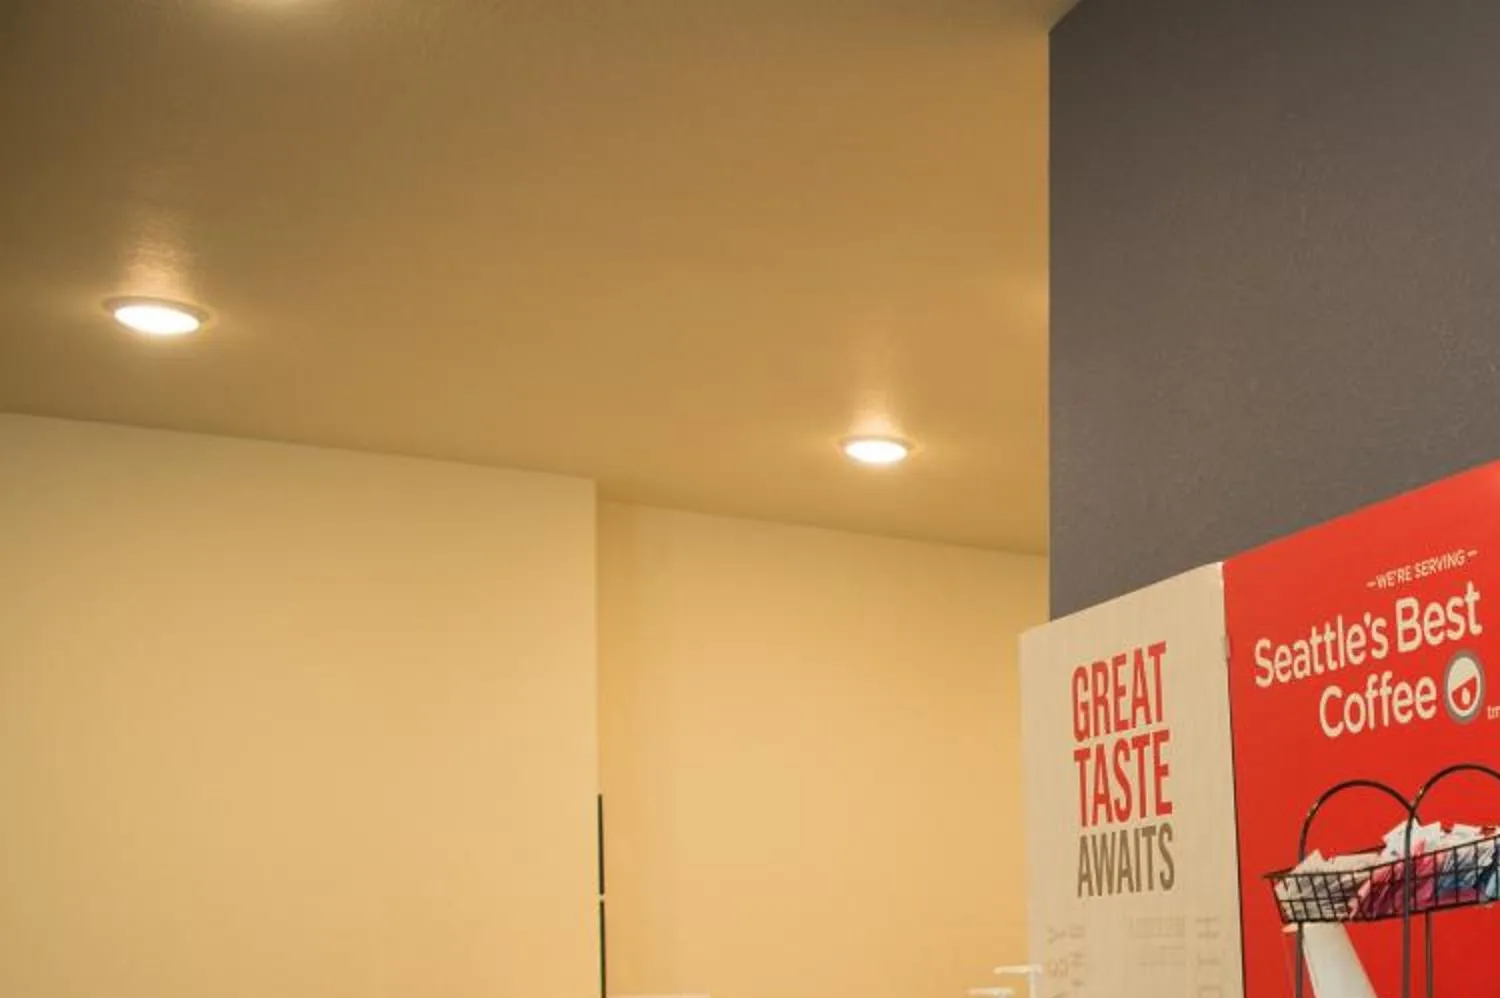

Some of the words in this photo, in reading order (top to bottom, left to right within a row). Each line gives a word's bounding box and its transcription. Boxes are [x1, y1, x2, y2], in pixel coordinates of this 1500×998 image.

[1376, 565, 1413, 588] WE'RE
[1415, 549, 1466, 579] SERVING
[1254, 611, 1388, 688] Seattle's
[1396, 580, 1483, 653] Best
[1071, 641, 1167, 742] GREAT
[1319, 670, 1437, 738] Coffee
[1073, 729, 1173, 828] TASTE
[1077, 822, 1175, 898] AWAITS
